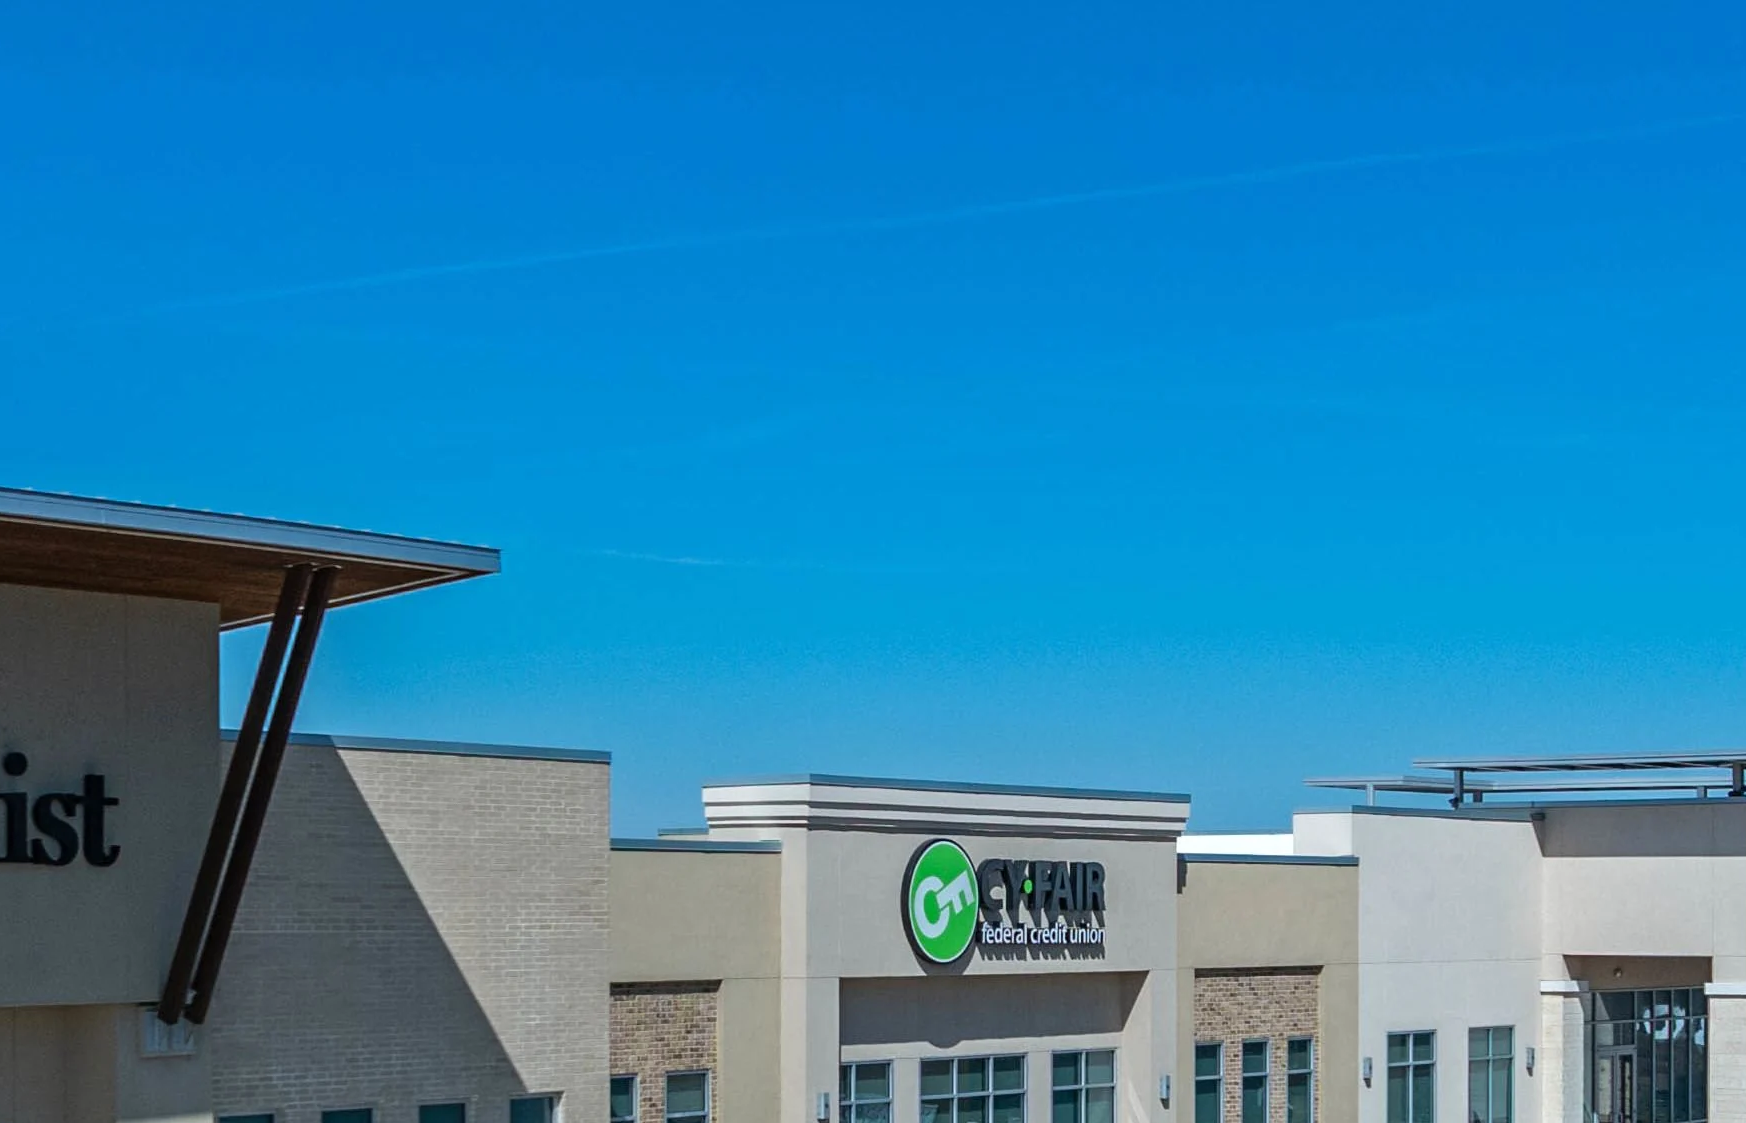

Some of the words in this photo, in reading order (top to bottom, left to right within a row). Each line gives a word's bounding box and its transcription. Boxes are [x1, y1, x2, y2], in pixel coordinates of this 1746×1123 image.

[981, 922, 1027, 945] federal
[1030, 923, 1068, 945] credit
[1070, 923, 1105, 944] union
